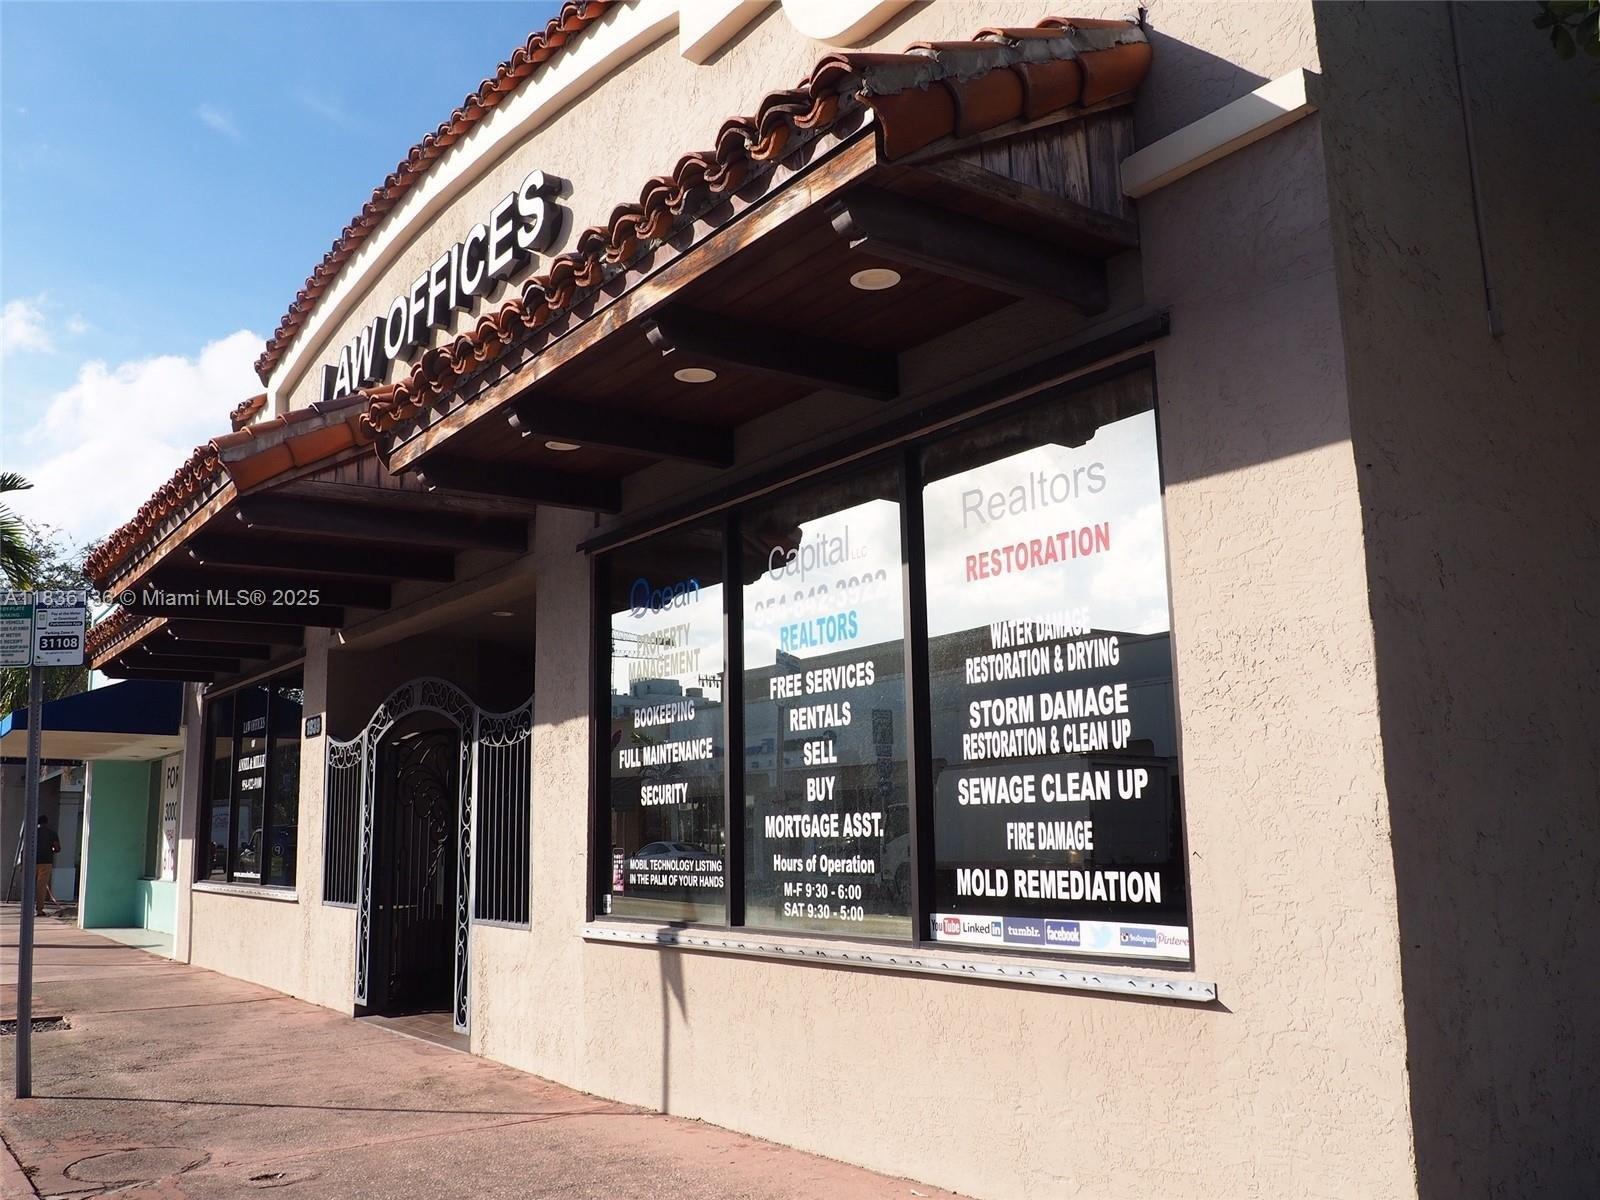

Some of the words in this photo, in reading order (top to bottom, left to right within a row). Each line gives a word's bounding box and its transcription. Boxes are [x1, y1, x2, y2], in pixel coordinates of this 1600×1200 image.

[384, 168, 551, 359] OFFICES
[962, 461, 1107, 529] Realtors
[768, 525, 849, 582] Capital
[965, 522, 1111, 583] RESTORATION
[628, 577, 700, 618] Ocean
[41, 638, 78, 649] 31108
[636, 623, 691, 657] PROPERTY
[780, 610, 858, 653] REALTORS
[990, 618, 1034, 650] WATER
[1035, 606, 1091, 643] DAMAGE
[628, 648, 701, 682] MANAGEMENT
[965, 646, 1050, 685] RESTORATION
[1053, 644, 1064, 673] &
[1067, 635, 1120, 672] DRYING
[769, 674, 802, 700] FREE
[805, 661, 875, 694] SERVICES
[634, 700, 696, 729] BOOKEEPING
[789, 701, 852, 732] RENTALS
[969, 695, 1034, 729] STORM
[1040, 683, 1129, 722] DAMAGE
[619, 747, 642, 769] FULL
[643, 737, 713, 766] MAINTENANCE
[803, 740, 838, 766] SELL
[962, 725, 1047, 760] RESTORATION
[1050, 725, 1060, 755] &
[1063, 721, 1109, 753] CLEAN
[1111, 718, 1131, 749] UP
[641, 782, 689, 807] SECURITY
[806, 776, 836, 802] BUY
[957, 775, 1036, 806] SEWAGE
[1041, 770, 1111, 803] CLEAN
[1117, 768, 1149, 800] UP
[764, 813, 839, 838] MORTGAGE
[843, 812, 884, 837] ASST.
[1006, 822, 1035, 850] FIRE
[1038, 820, 1094, 851] DAMAGE
[629, 859, 649, 870] MOBIL
[650, 859, 695, 872] TECHNOLOGY
[695, 860, 723, 872] LISTING
[629, 873, 636, 884] IN
[637, 874, 649, 885] THE
[650, 874, 667, 886] PALM
[668, 874, 678, 886] OF
[679, 875, 698, 887] YOUR
[699, 875, 724, 888] HANDS
[773, 854, 804, 872] Hours
[805, 854, 817, 872] of
[819, 854, 875, 877] Operation
[784, 882, 803, 897] M-F
[837, 884, 862, 900] 6:00
[956, 868, 1009, 898] MOLD
[1013, 869, 1162, 904] REMEDIATION
[784, 902, 805, 917] SAT
[807, 903, 830, 919] 9:30
[840, 905, 864, 922] 5:00
[1046, 925, 1080, 942] facebook
